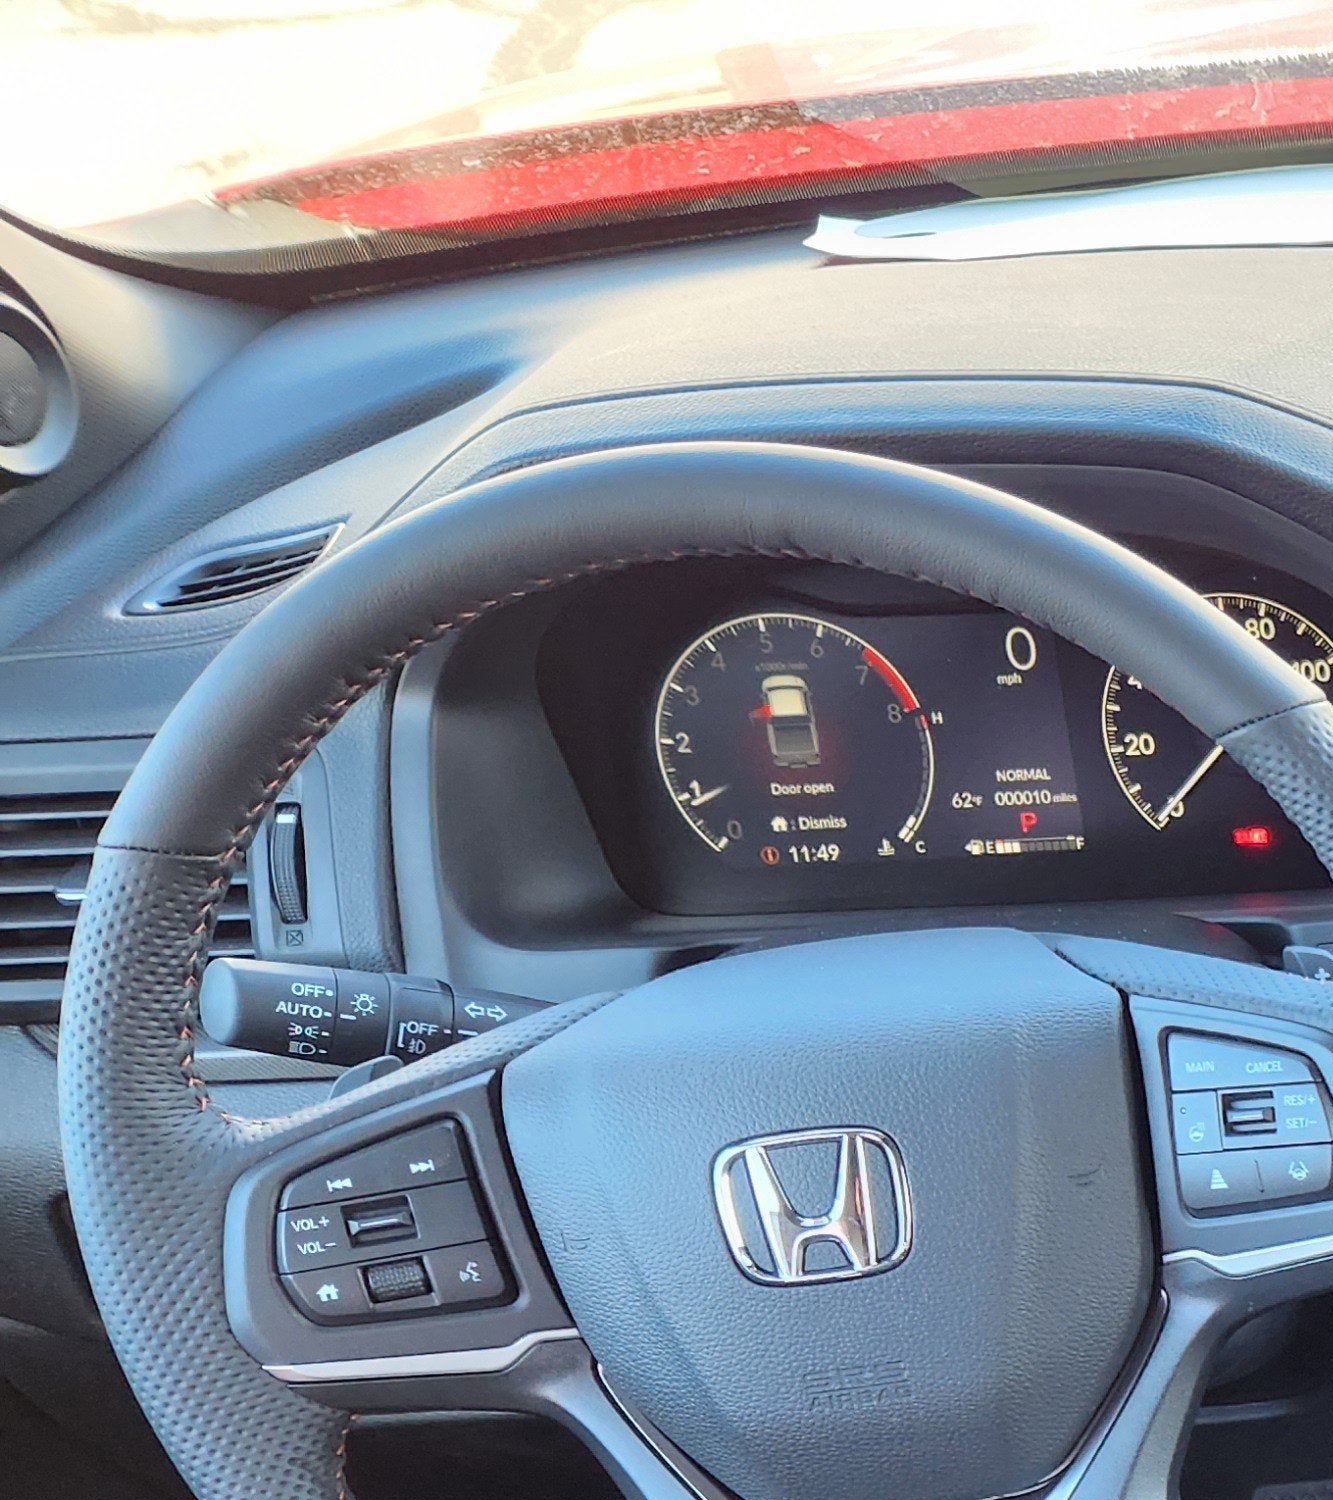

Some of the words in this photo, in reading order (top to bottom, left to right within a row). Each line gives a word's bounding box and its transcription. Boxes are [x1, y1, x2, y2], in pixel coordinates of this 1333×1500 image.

[1245, 618, 1275, 640] 80
[760, 634, 773, 653] 5
[810, 639, 824, 658] 6
[1004, 626, 1037, 671] 0
[710, 653, 727, 672] 4
[855, 665, 869, 686] 7
[996, 673, 1022, 686] mph
[686, 685, 700, 705] 3
[886, 703, 902, 723] 8
[931, 711, 943, 725] H
[675, 732, 693, 753] 2
[1123, 732, 1155, 757] 20
[995, 768, 1051, 782] NORMAL
[688, 780, 702, 799] 1
[770, 782, 802, 796] Door
[803, 783, 835, 796] open
[994, 790, 1051, 806] 000010
[1052, 792, 1078, 803] miles
[727, 820, 742, 840] 0
[798, 815, 847, 830] Dismiss
[1020, 812, 1038, 833] P
[915, 840, 927, 853] C
[986, 841, 995, 854] E
[1076, 836, 1085, 850] F
[788, 844, 840, 863] 11:49
[291, 983, 325, 997] OFF
[276, 1001, 323, 1018] AUTO
[406, 1021, 439, 1036] OFF
[1185, 1060, 1215, 1073] MAIN
[1245, 1061, 1284, 1074] CANCEL
